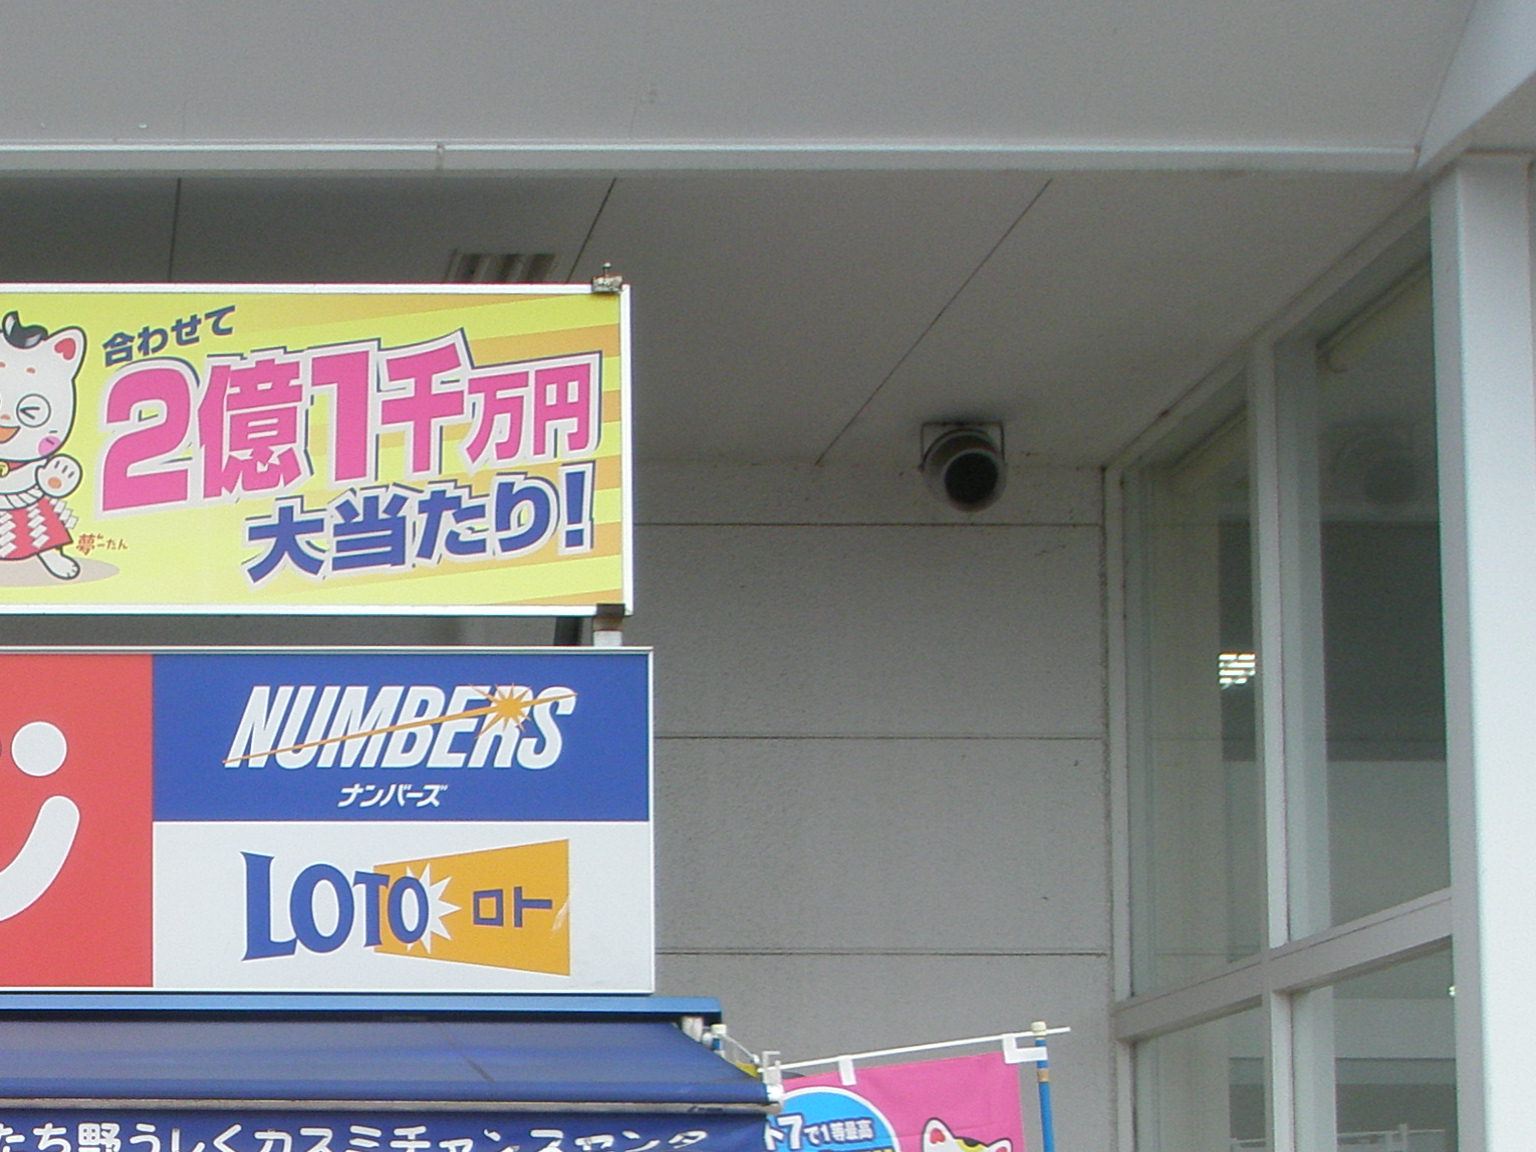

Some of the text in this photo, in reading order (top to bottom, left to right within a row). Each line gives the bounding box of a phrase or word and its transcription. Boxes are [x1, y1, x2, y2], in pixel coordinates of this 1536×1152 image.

[102, 305, 236, 367] 合わせて
[101, 342, 599, 511] 2億1千万円
[247, 468, 595, 584] 大当たり!
[223, 684, 577, 770] NUMBERS
[336, 782, 449, 808] ナンバーズ
[240, 851, 553, 962] LOTO ロト
